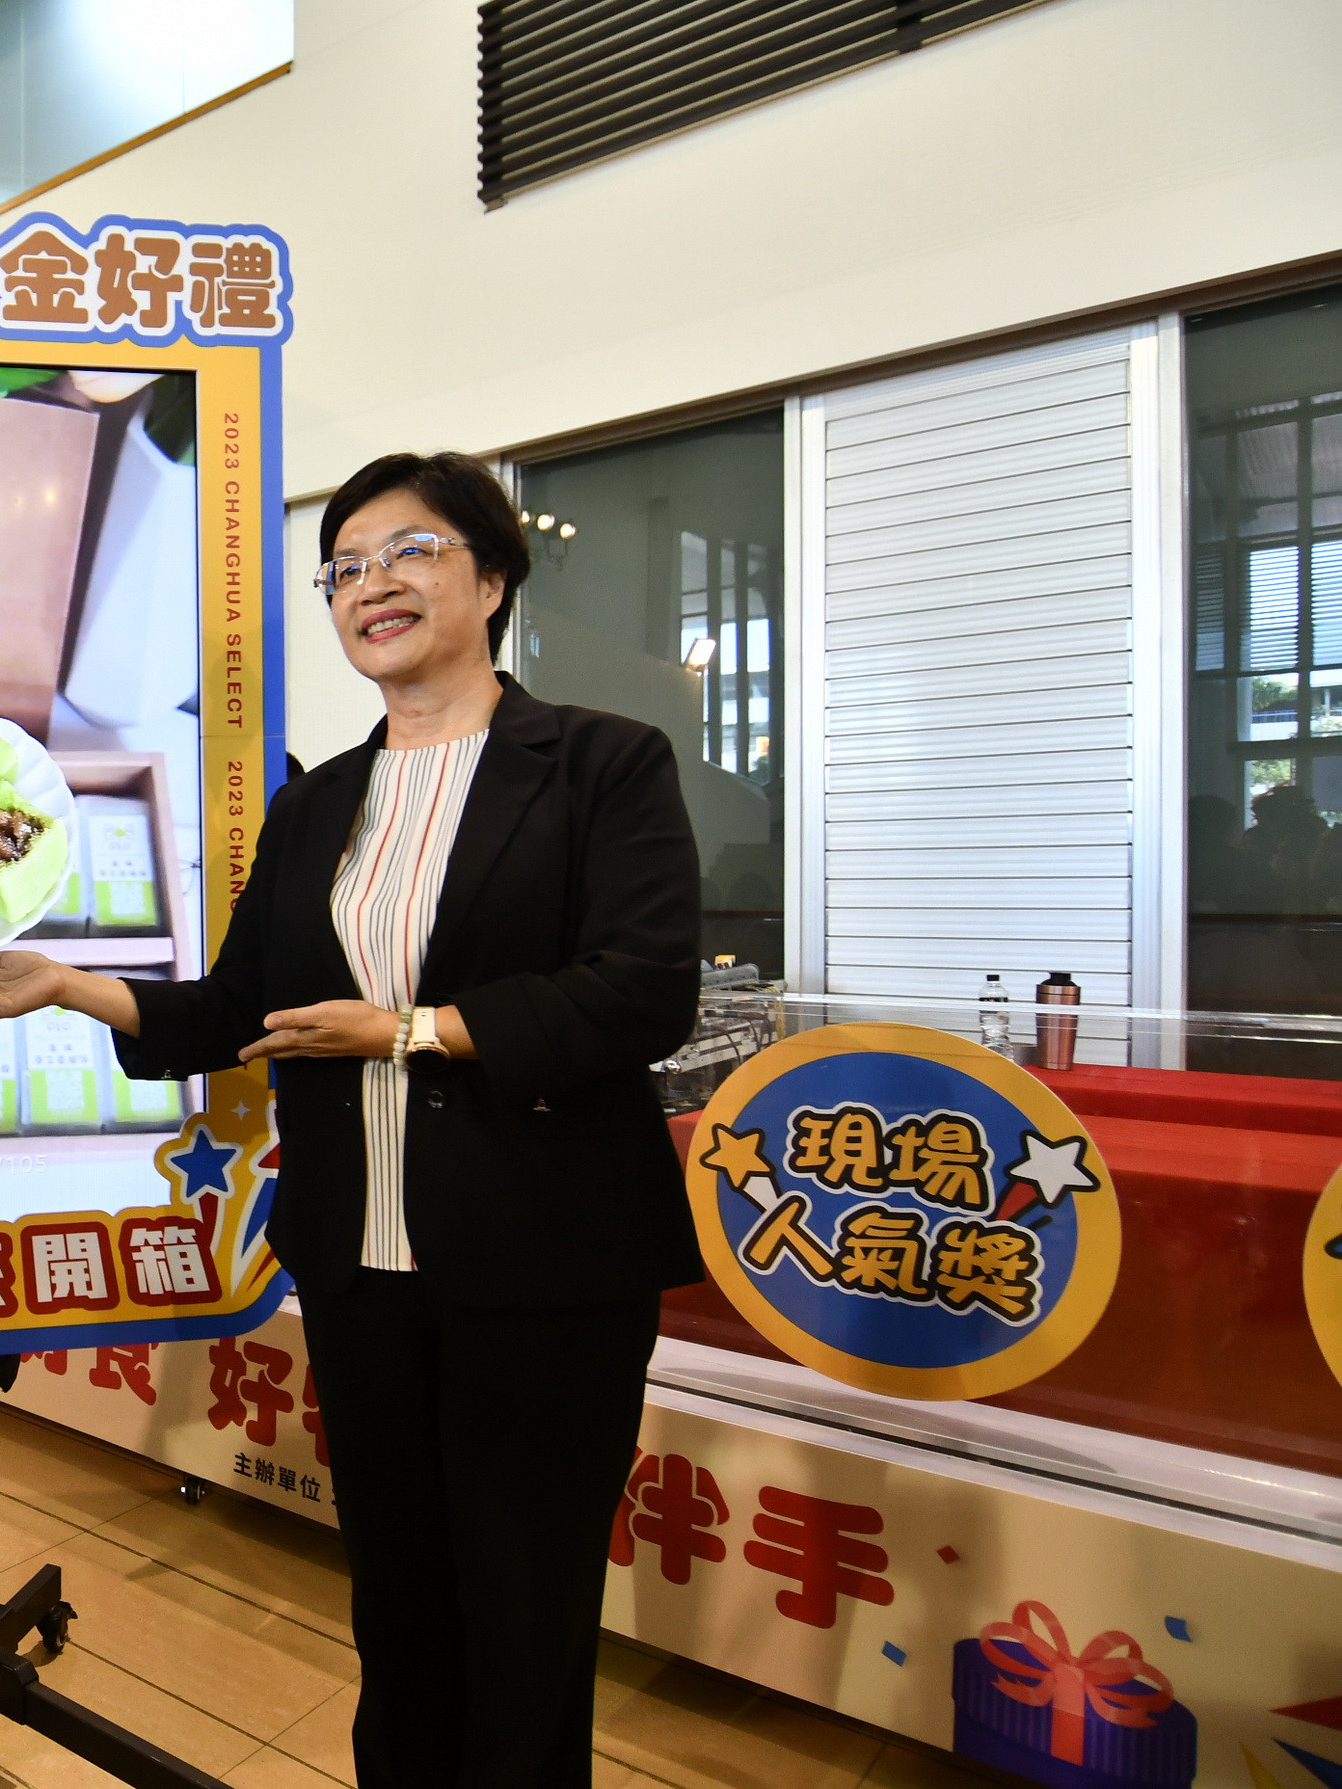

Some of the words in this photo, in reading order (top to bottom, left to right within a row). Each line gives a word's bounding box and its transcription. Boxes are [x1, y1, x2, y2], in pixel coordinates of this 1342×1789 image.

[222, 412, 240, 471] 2023
[224, 480, 244, 623] CHANGHUA
[227, 632, 244, 730] SELECT
[226, 760, 244, 818] 2023
[228, 826, 246, 912] CHAN
[788, 1106, 992, 1212] 現場
